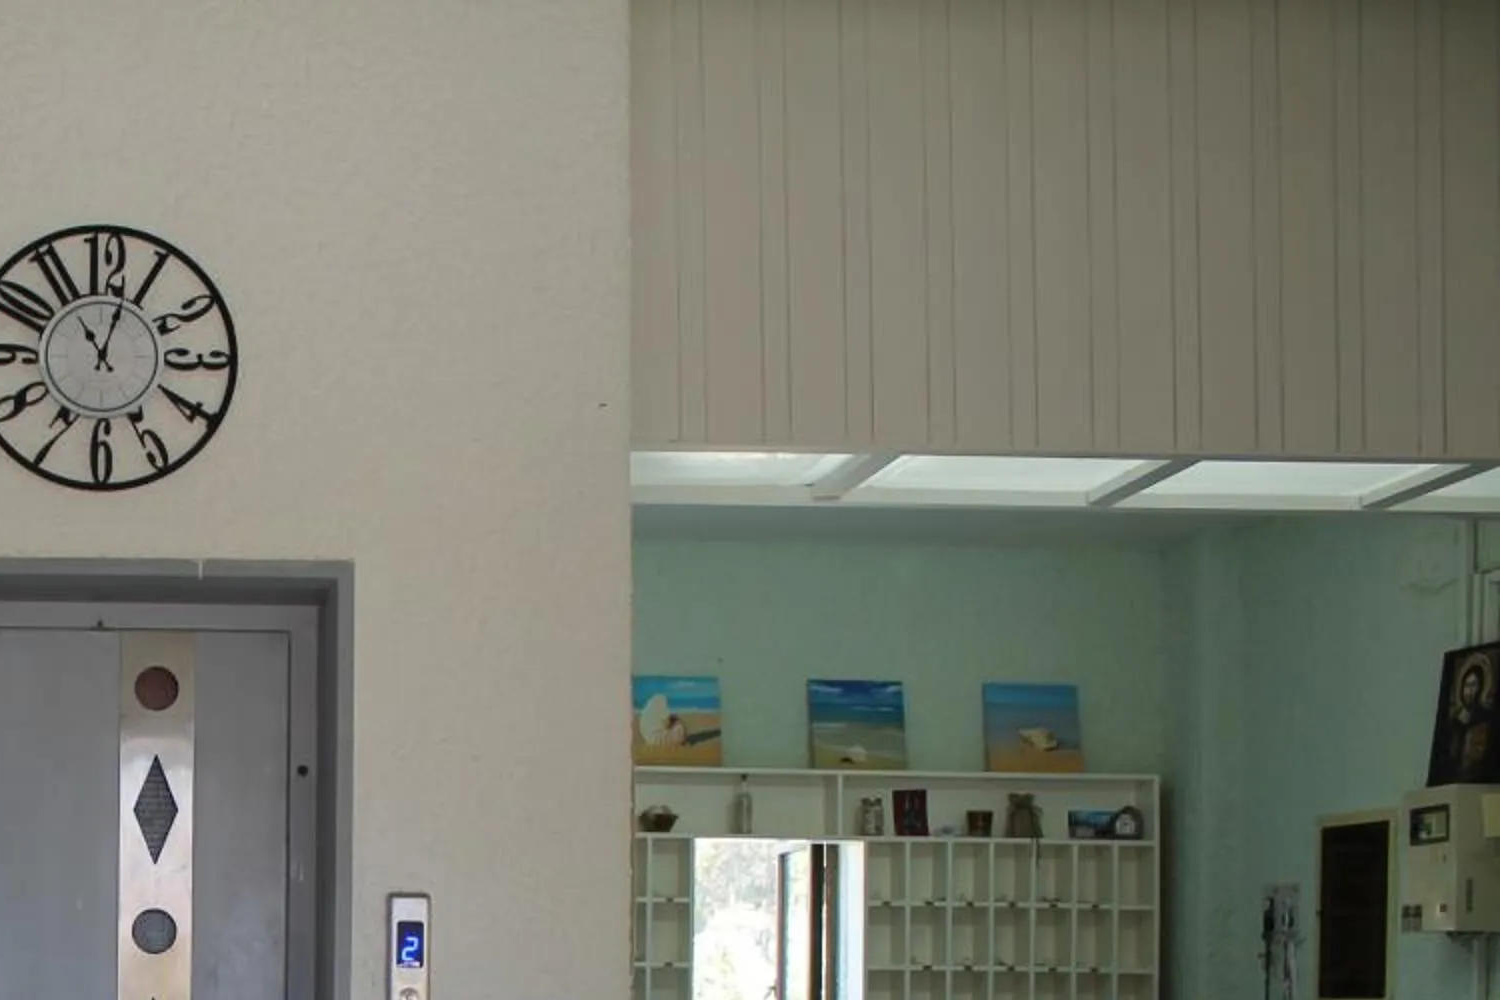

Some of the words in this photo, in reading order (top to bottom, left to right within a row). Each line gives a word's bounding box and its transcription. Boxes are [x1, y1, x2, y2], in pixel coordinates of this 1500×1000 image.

[29, 244, 82, 306] 11
[84, 232, 126, 298] 12
[131, 250, 170, 310] 1
[152, 295, 217, 336] 2
[164, 348, 230, 371] 3
[157, 384, 218, 428] 4
[34, 406, 80, 467] 7
[90, 418, 113, 484] 6
[127, 405, 169, 472] 5
[401, 937, 419, 961] 2
